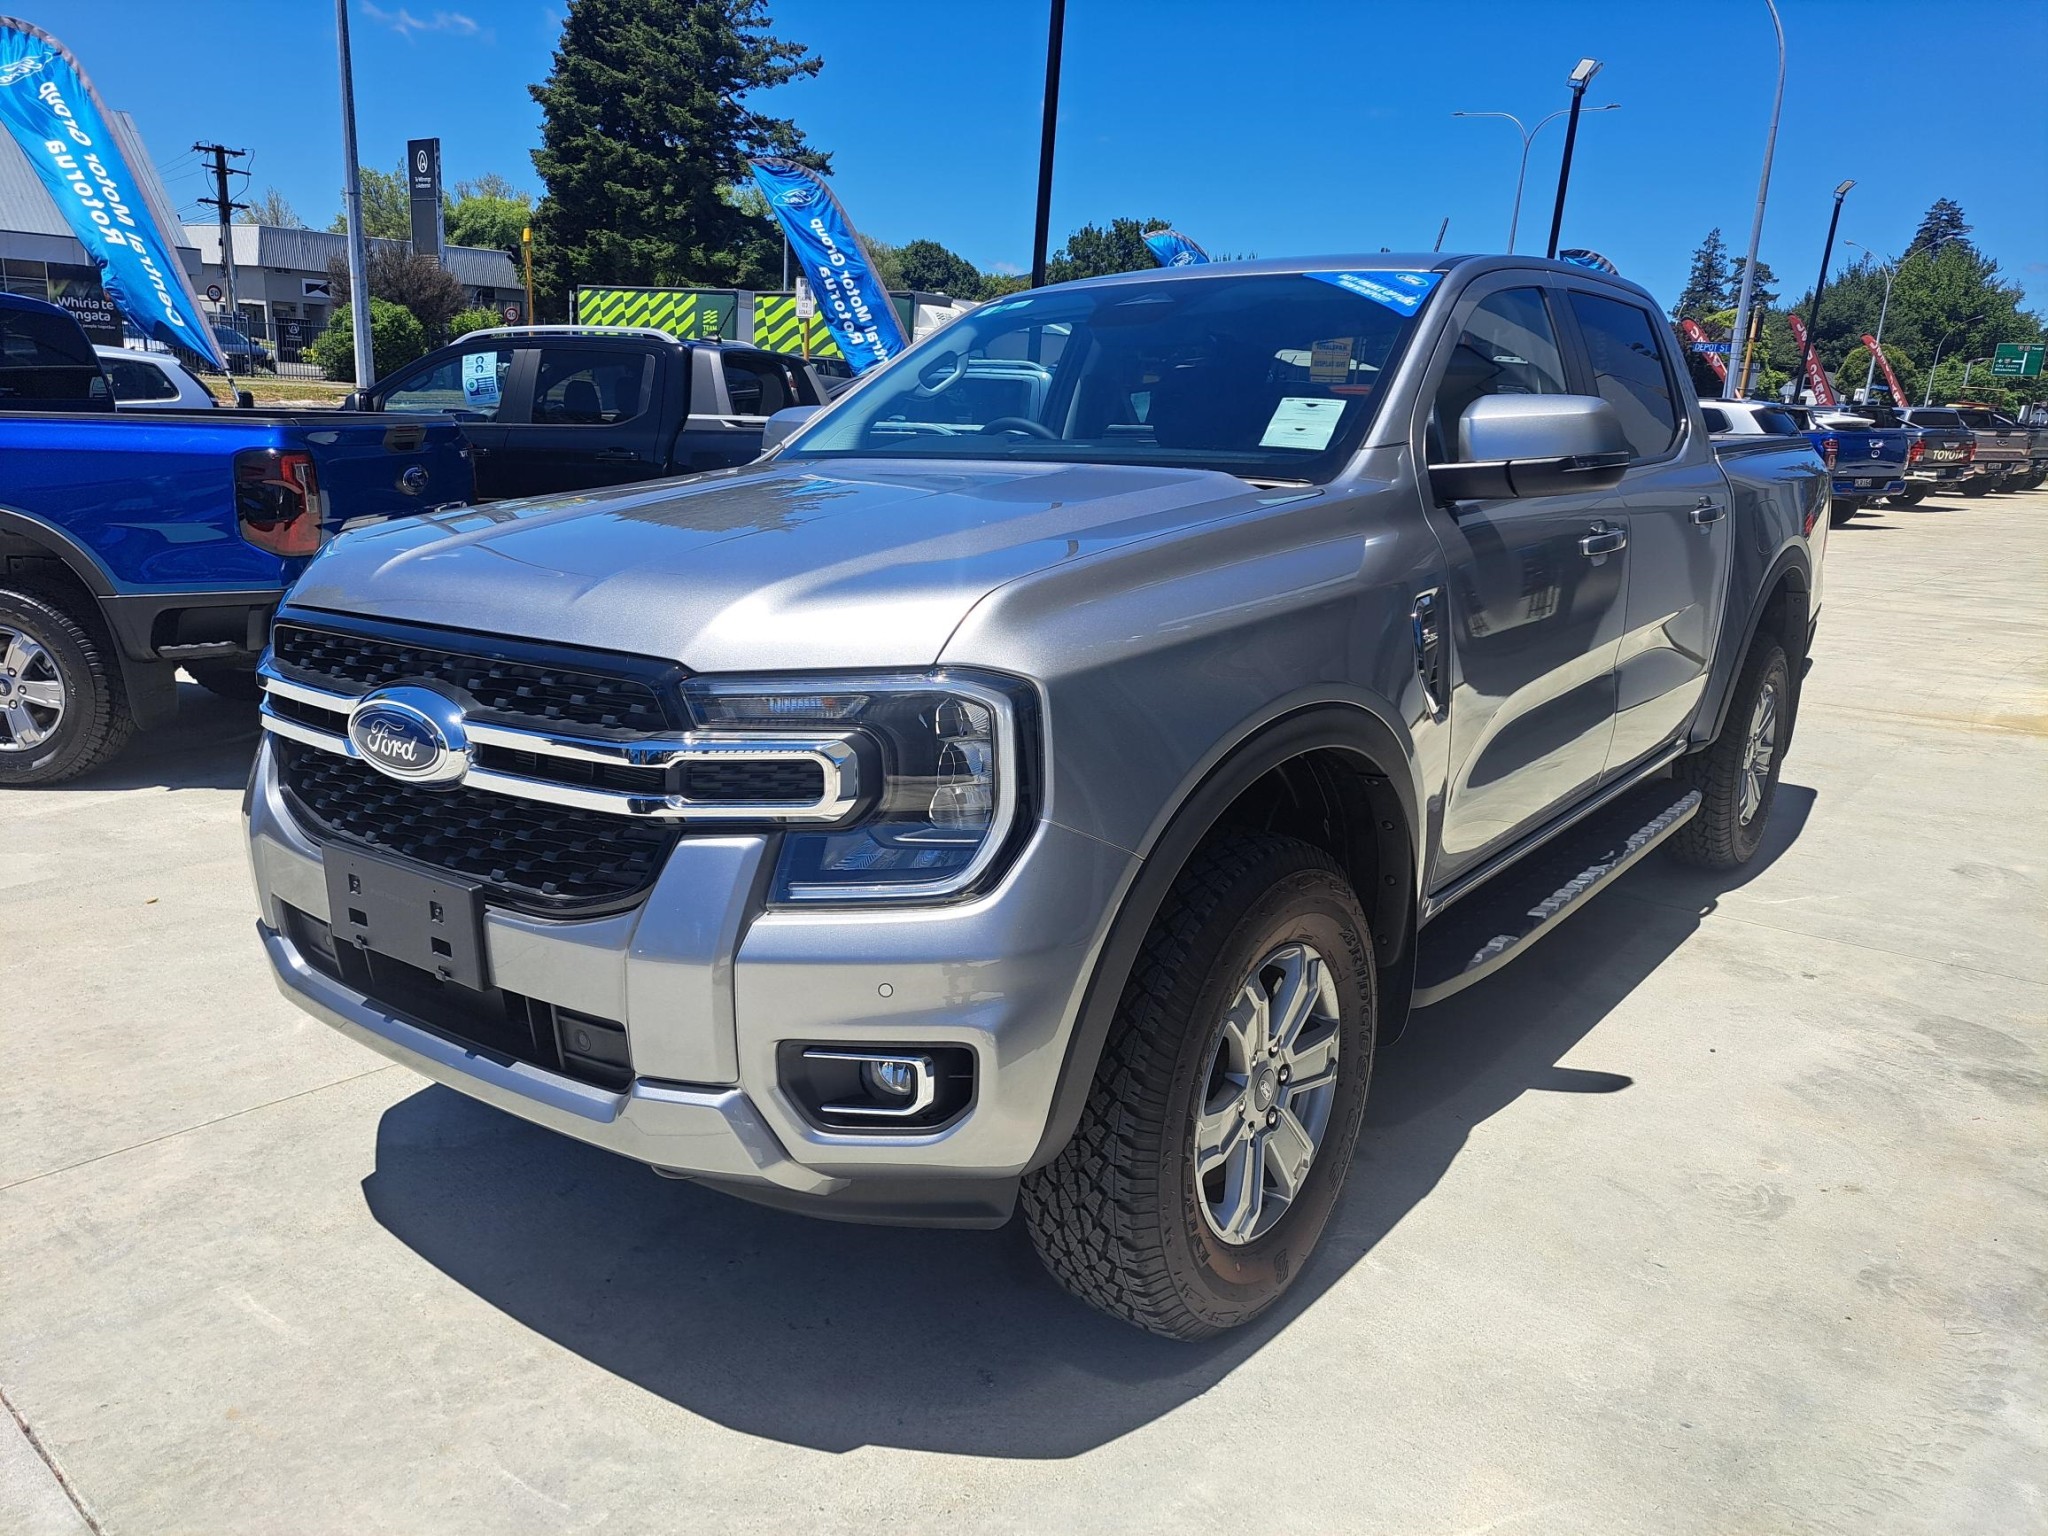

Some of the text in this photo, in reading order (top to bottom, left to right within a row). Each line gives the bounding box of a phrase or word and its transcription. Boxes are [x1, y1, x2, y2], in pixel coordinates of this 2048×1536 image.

[57, 296, 114, 310] Whiria te
[69, 310, 111, 323] angata
[1719, 344, 1729, 352] ST
[1933, 450, 1964, 460] TOYOTA
[367, 719, 418, 762] Ford
[1329, 928, 1372, 1194] BRIDGESTONE
